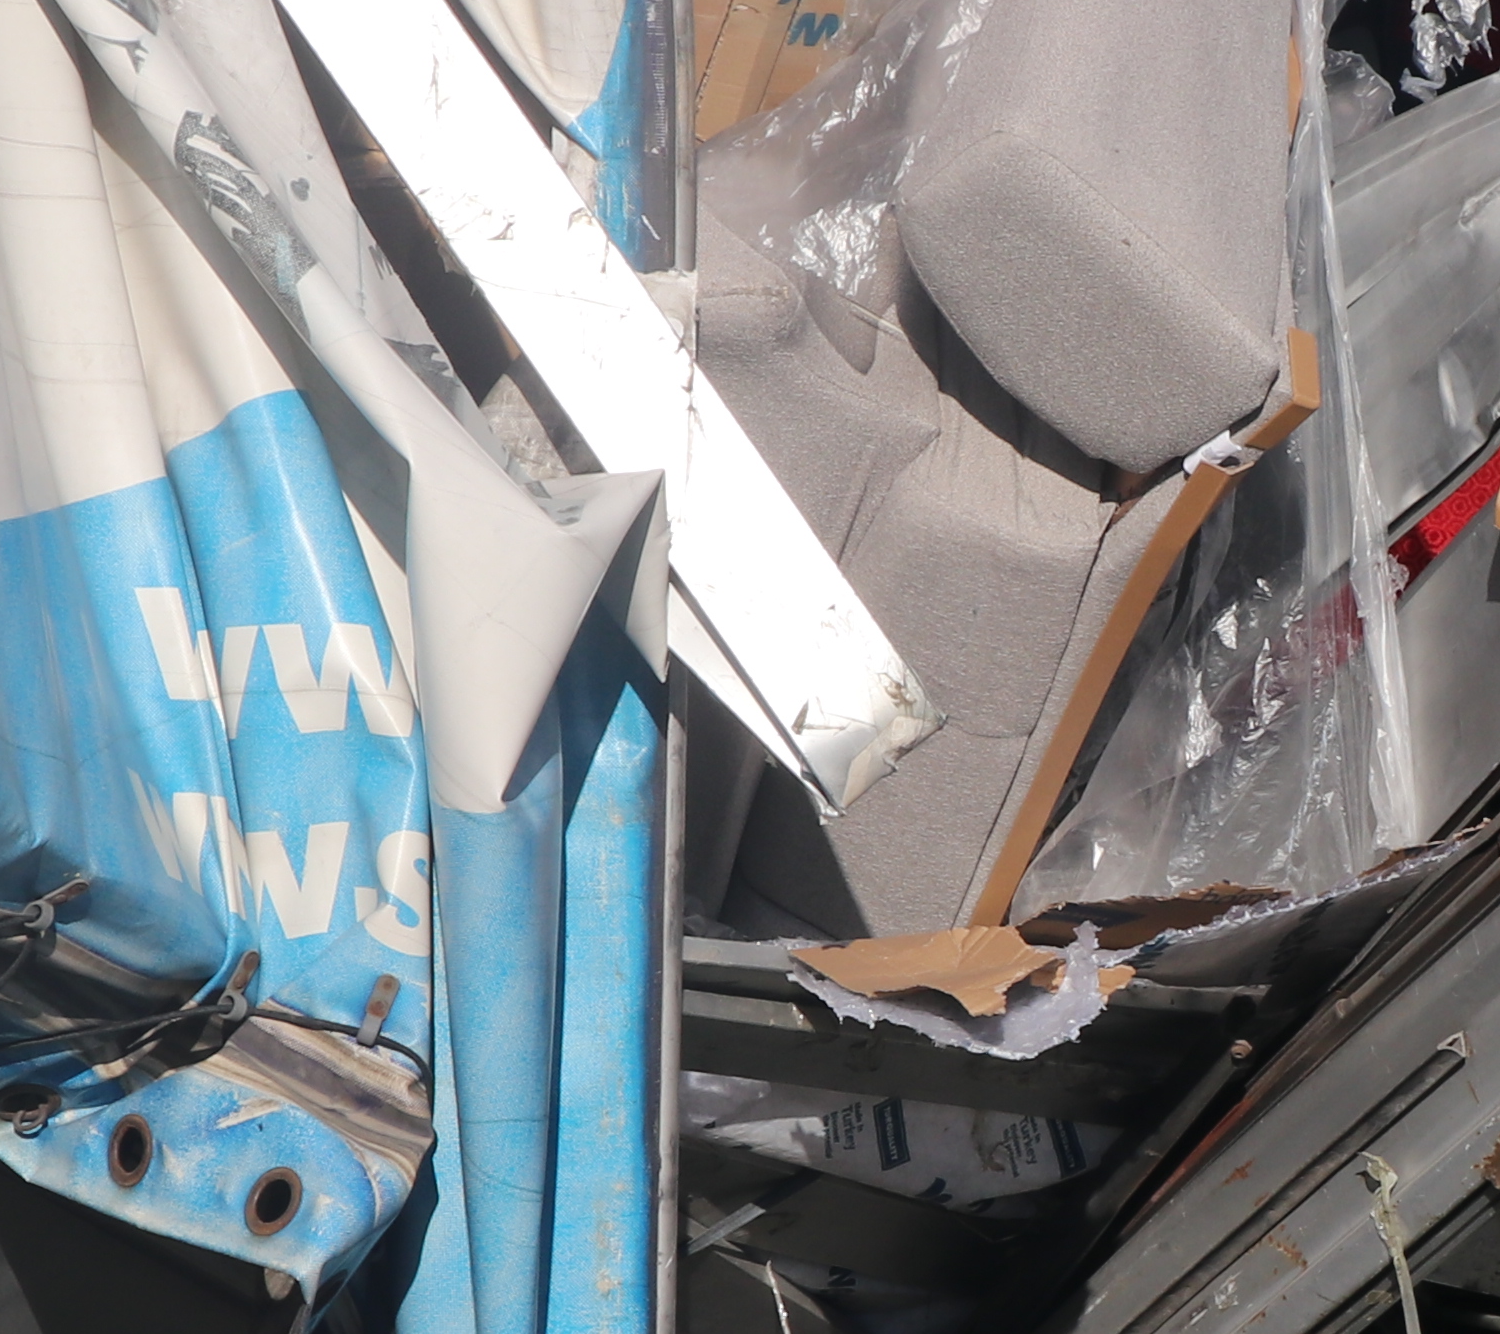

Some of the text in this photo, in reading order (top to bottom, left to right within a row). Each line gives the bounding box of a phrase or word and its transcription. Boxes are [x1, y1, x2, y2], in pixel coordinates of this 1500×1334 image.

[841, 1104, 856, 1150] Turkey
[883, 1105, 899, 1160] TURQUALITY
[1020, 1116, 1038, 1165] Turkey
